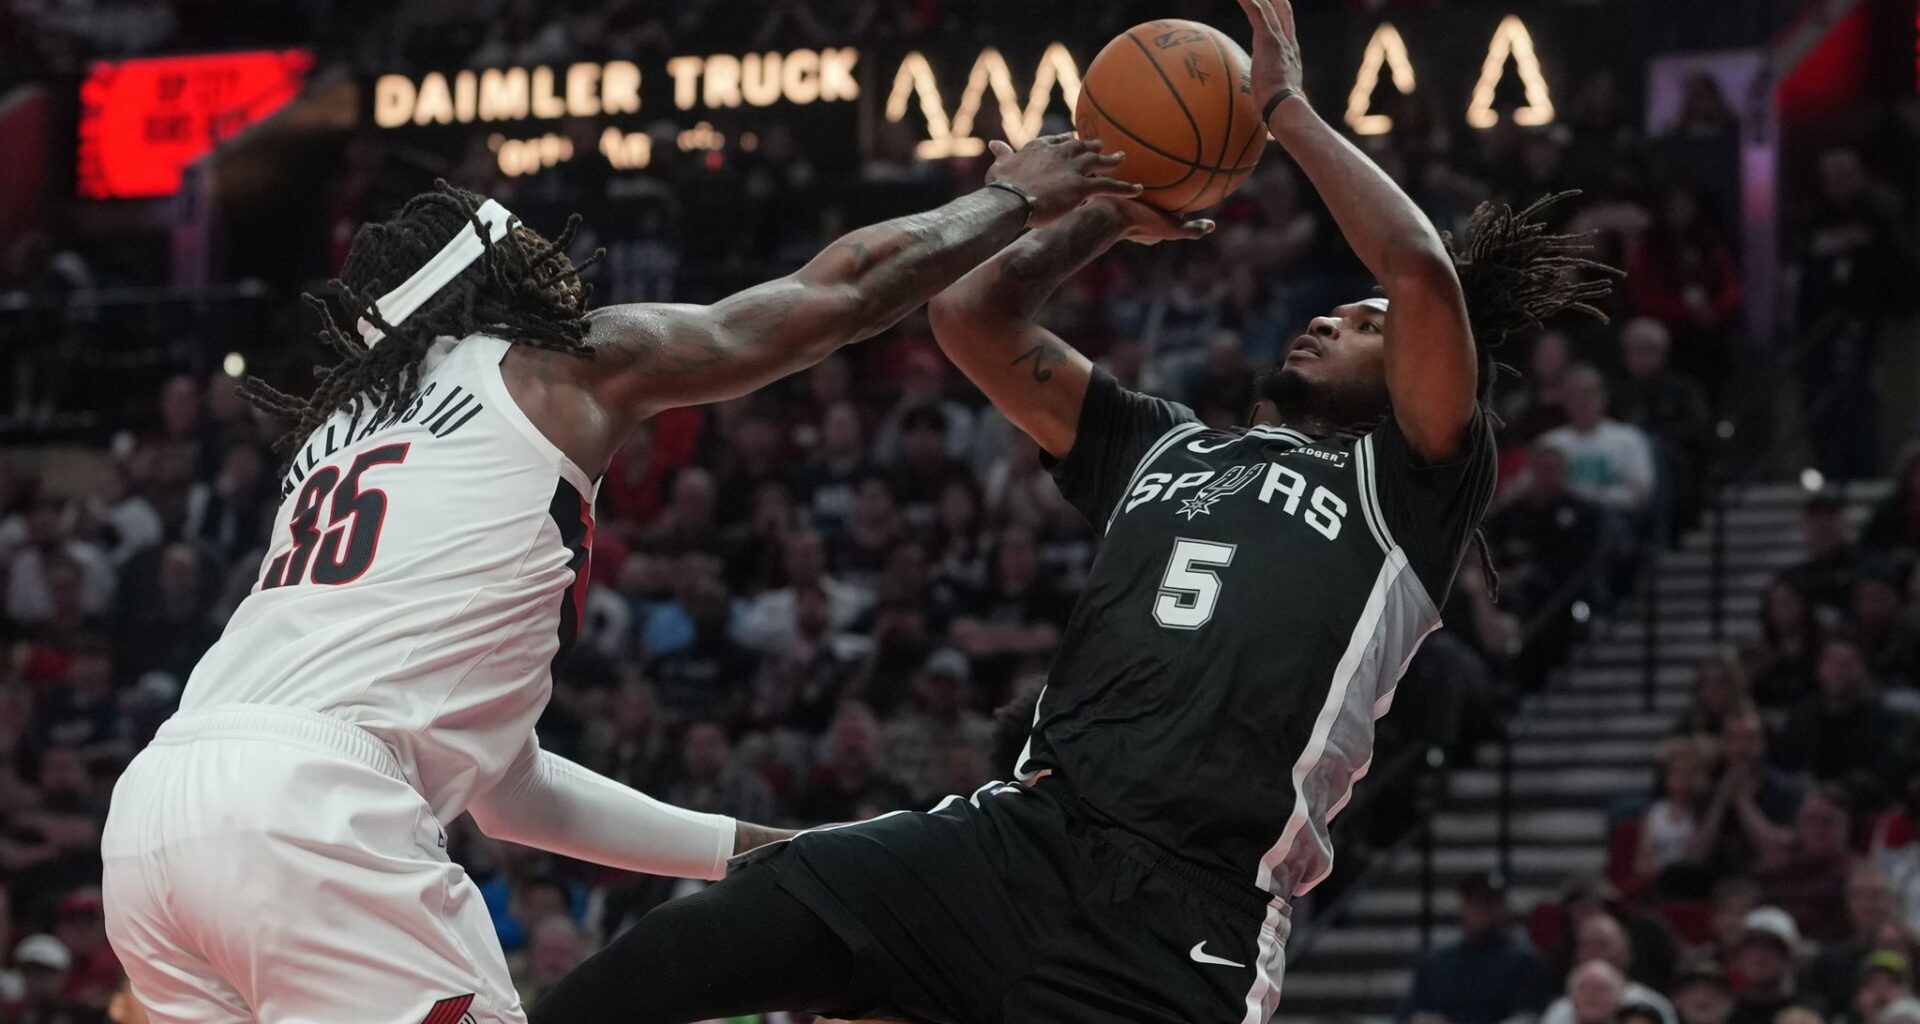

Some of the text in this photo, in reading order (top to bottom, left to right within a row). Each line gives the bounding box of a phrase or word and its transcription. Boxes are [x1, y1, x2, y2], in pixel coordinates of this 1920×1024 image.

[374, 46, 860, 128] DAIMLER TRUCK
[1125, 462, 1348, 541] SPURS
[1152, 536, 1238, 630] 5
